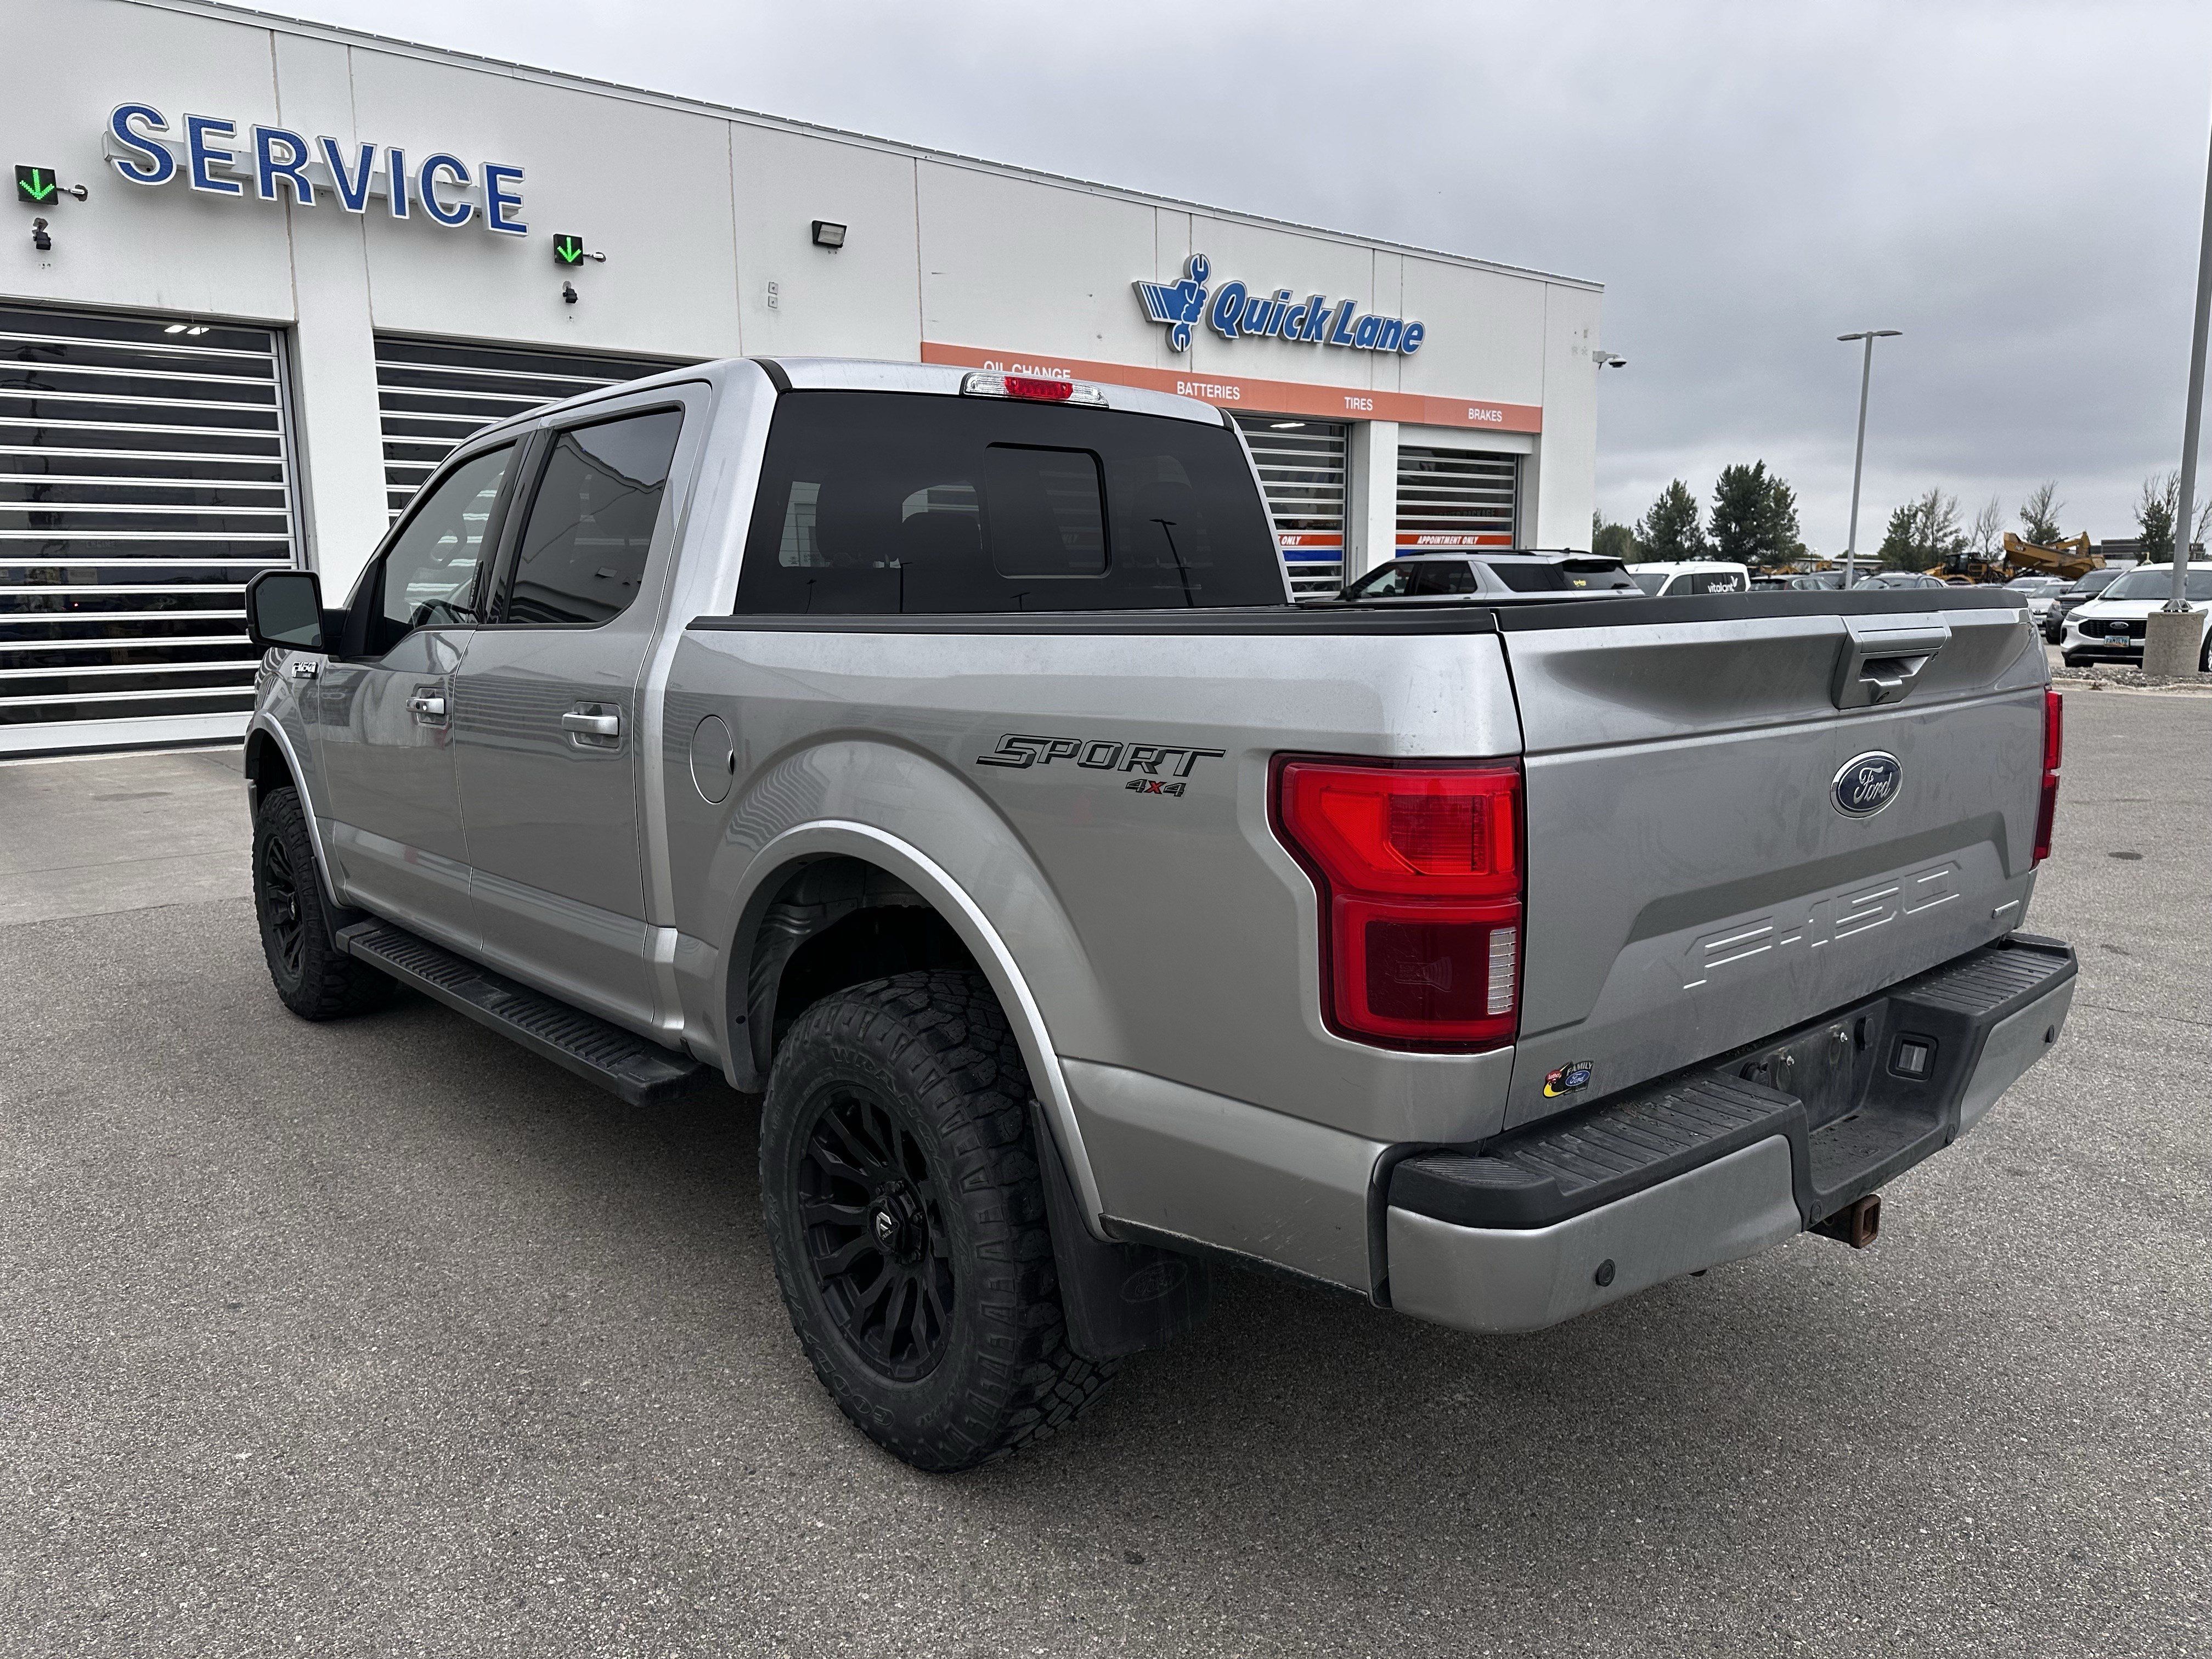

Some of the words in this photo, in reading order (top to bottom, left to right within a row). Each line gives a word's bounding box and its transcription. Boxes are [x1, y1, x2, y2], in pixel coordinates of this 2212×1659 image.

[108, 102, 529, 238] SERVICE
[1210, 280, 1334, 342] Quick
[1330, 300, 1426, 354] Lane
[1012, 364, 1071, 379] CHANGE
[1177, 381, 1240, 400] BATTERIES
[1345, 397, 1373, 411] TIRES
[1468, 408, 1502, 422] BRAKES
[1281, 535, 1301, 545] ONLY
[1417, 536, 1462, 544] APPOINTMENT
[1462, 536, 1479, 544] ONLY
[1707, 582, 1735, 593] vitalant
[976, 733, 1227, 777] SPORT
[1853, 766, 1893, 804] Ford
[1683, 860, 1963, 989] F-150
[1566, 1062, 1593, 1076] FAMILY
[1570, 1073, 1586, 1084] Ford
